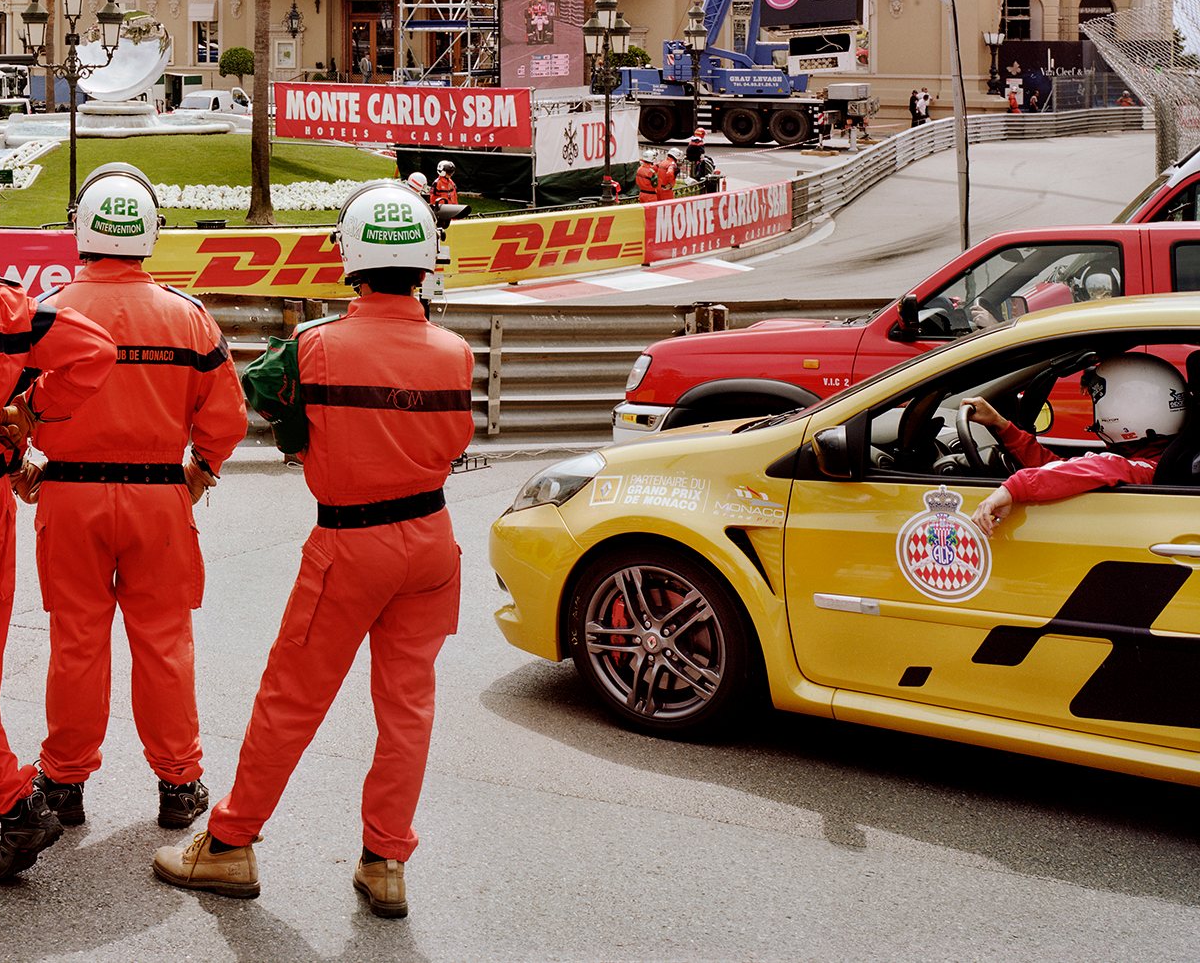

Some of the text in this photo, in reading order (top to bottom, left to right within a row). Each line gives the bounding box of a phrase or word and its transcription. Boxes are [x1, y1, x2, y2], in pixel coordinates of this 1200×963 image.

[729, 75, 783, 83] GRAU LEVAGE
[1056, 67, 1076, 76] Cleef
[285, 89, 518, 127] MONTE CARLO SBM
[304, 125, 495, 143] HOTELS & CASINOS
[100, 197, 139, 217] 422
[373, 202, 414, 223] 222
[654, 183, 788, 244] MONTE CARLO SBM
[94, 221, 142, 235] INTERVENTION
[366, 229, 422, 241] INTERVENTION
[488, 215, 623, 273] DHL
[671, 222, 782, 258] HOTELS & CASINOS
[129, 349, 140, 360] DE
[141, 349, 175, 361] MONACO
[843, 378, 850, 387] 2
[386, 388, 423, 410] ACM
[629, 474, 707, 489] PARTENAIRE DU
[626, 485, 702, 501] GRAND PRIX
[623, 495, 641, 505] DE
[642, 497, 698, 511] MONACO
[714, 501, 785, 519] MONACO
